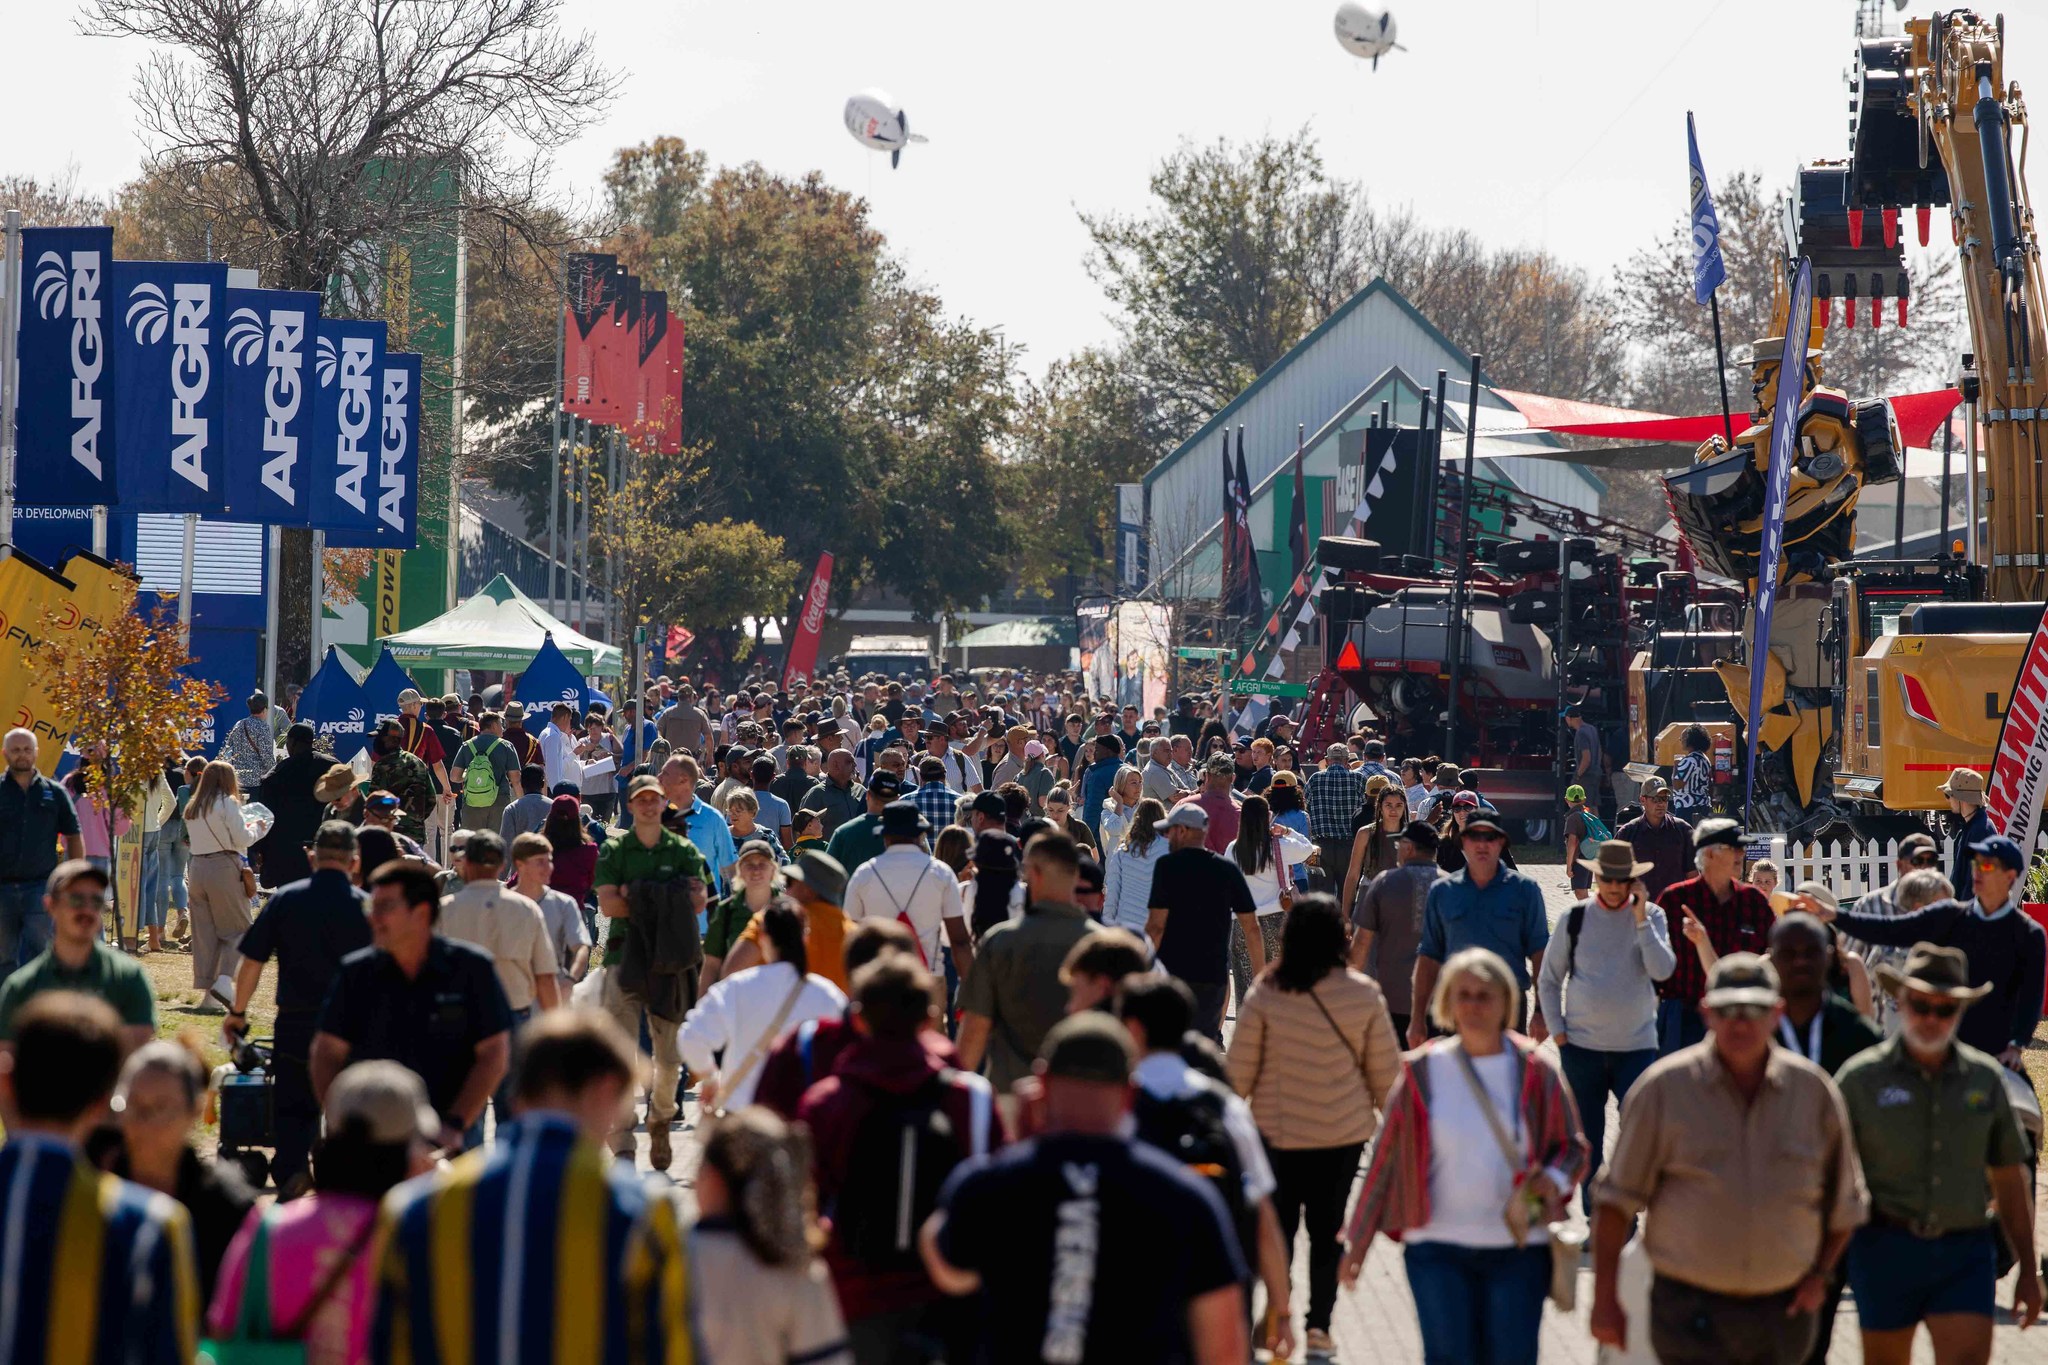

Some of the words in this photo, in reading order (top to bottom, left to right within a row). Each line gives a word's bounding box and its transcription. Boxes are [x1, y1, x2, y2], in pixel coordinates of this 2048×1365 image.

[71, 250, 103, 482] AFGRI
[170, 283, 211, 493] AFGRI
[260, 309, 305, 507] AFGRI
[335, 337, 374, 515] AFGRI
[378, 368, 409, 534] AFGRI
[25, 507, 93, 519] DEVELOPMENT
[319, 721, 365, 734] AFGRI
[1235, 682, 1261, 693] AFGRI
